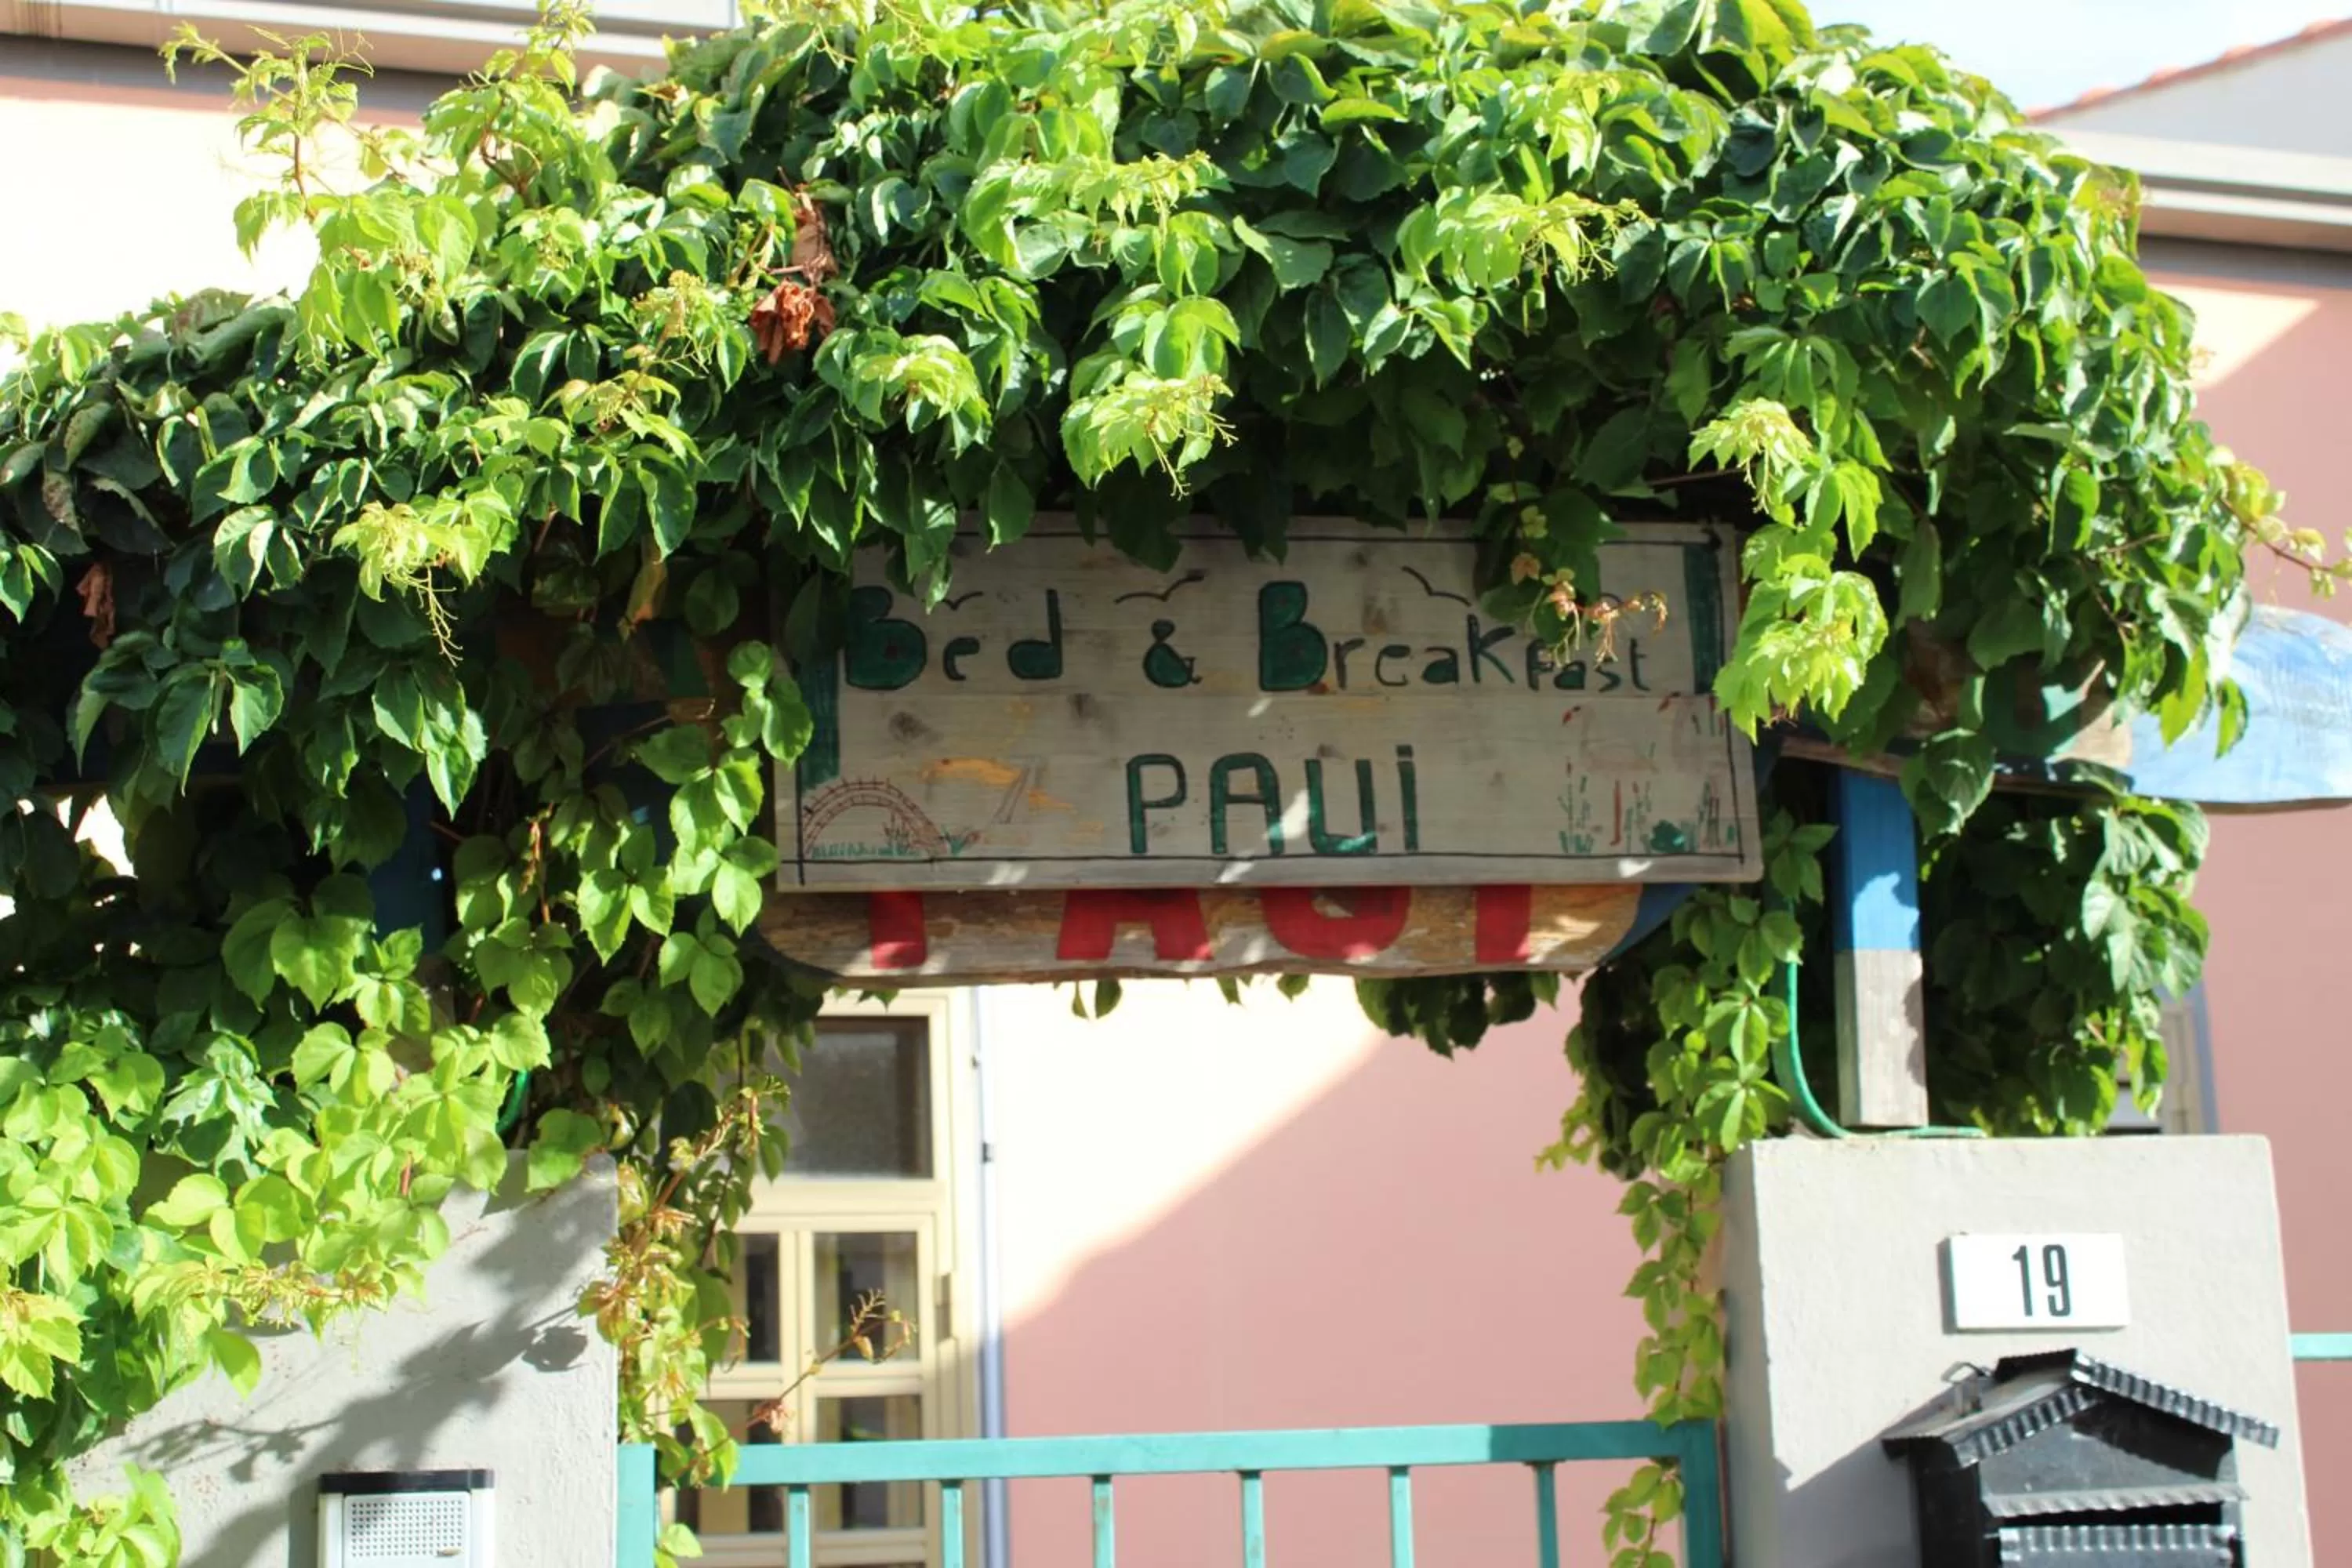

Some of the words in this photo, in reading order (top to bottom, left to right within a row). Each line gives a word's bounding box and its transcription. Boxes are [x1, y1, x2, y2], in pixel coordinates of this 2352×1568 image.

[844, 586, 1062, 690] Bed
[1142, 619, 1203, 687] &
[2012, 1244, 2071, 1317] 19
